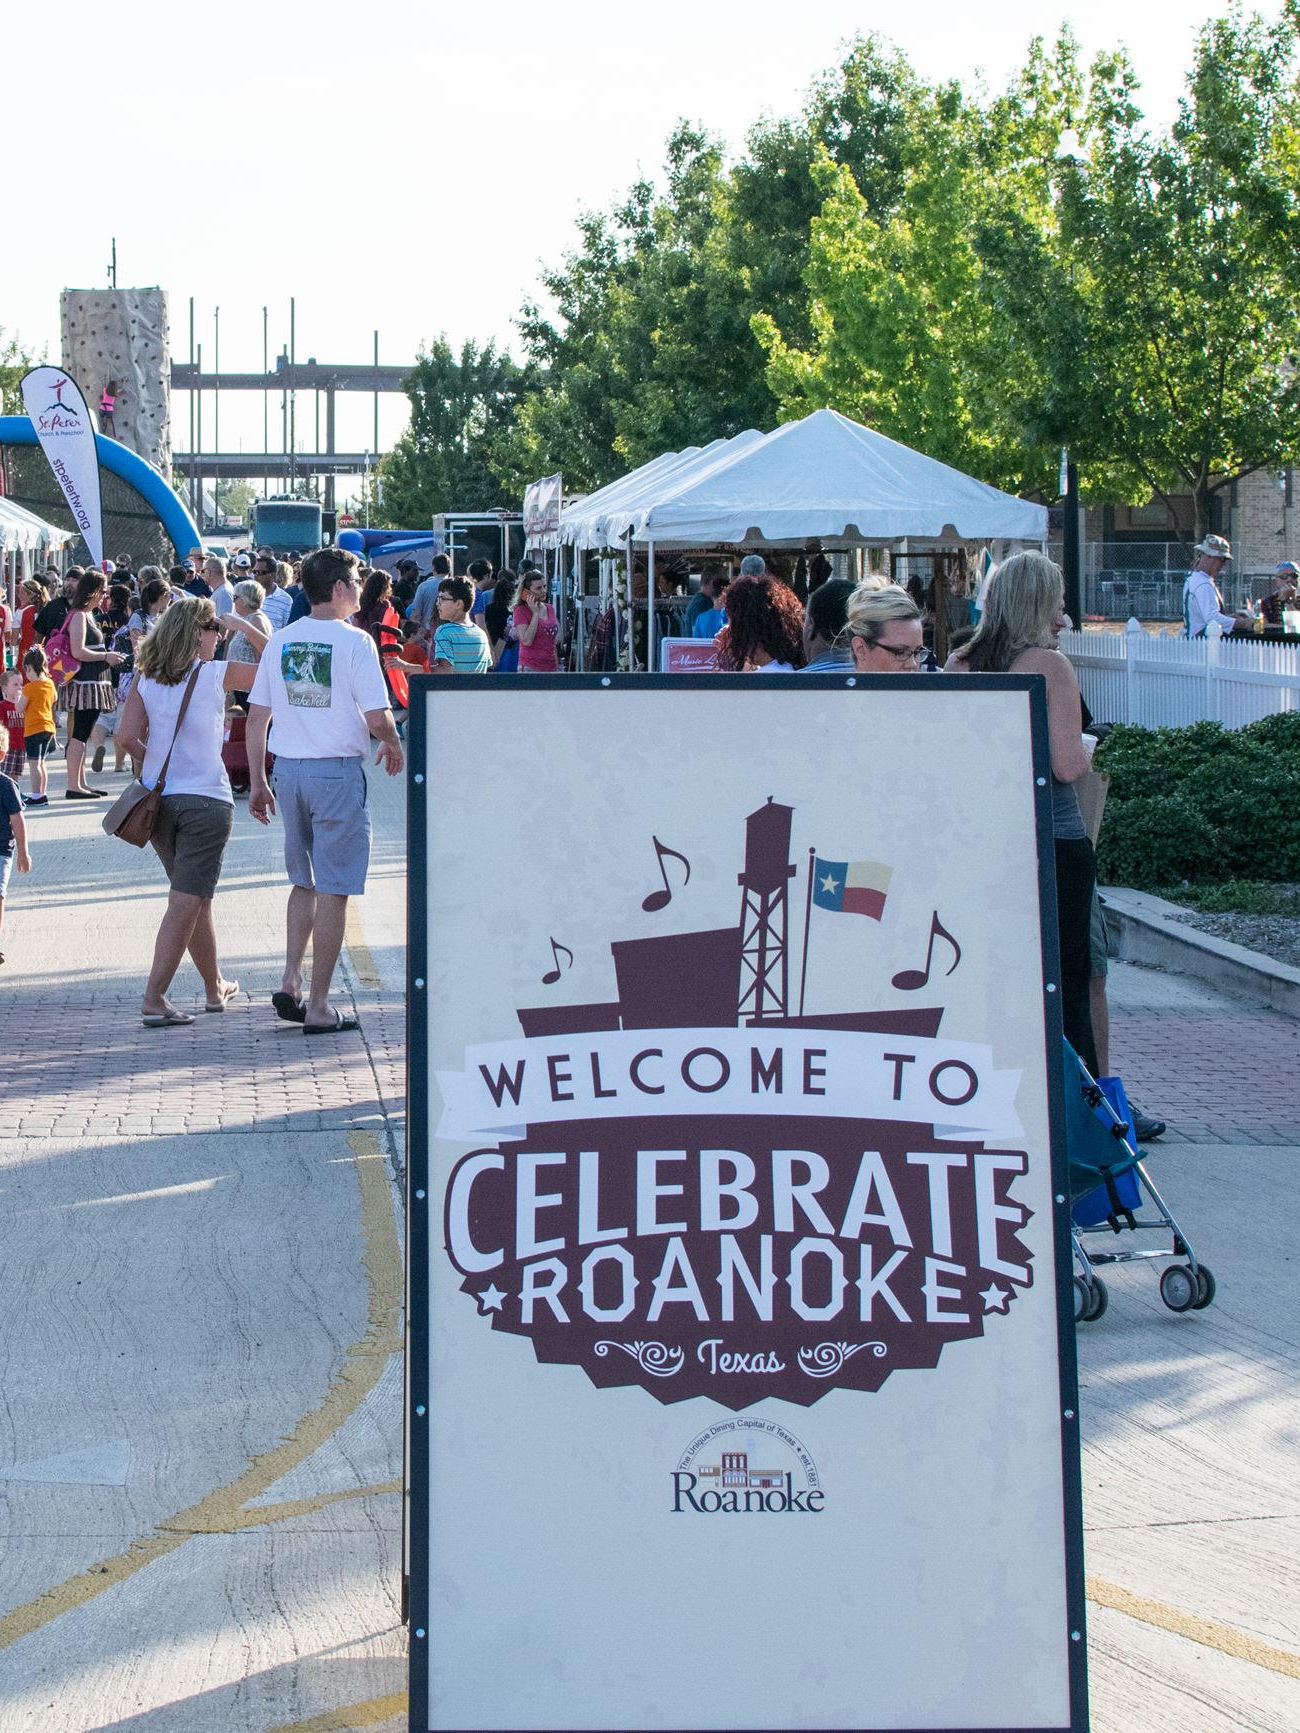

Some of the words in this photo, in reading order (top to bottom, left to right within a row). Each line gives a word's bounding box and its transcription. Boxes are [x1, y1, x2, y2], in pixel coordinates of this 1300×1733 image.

[53, 458, 91, 531] stpeterfw.org
[478, 1047, 827, 1108] WELCOME
[883, 1052, 979, 1106] TO
[448, 1149, 1030, 1284] CELEBRATE
[518, 1235, 971, 1324] ROANOKE
[697, 1339, 786, 1376] Texas
[679, 1455, 692, 1471] The
[688, 1433, 711, 1455] Unique
[710, 1421, 736, 1436] Dining
[736, 1419, 766, 1429] Capital
[767, 1424, 776, 1432] of
[776, 1427, 797, 1447] Texas
[670, 1472, 825, 1513] Roanoke
